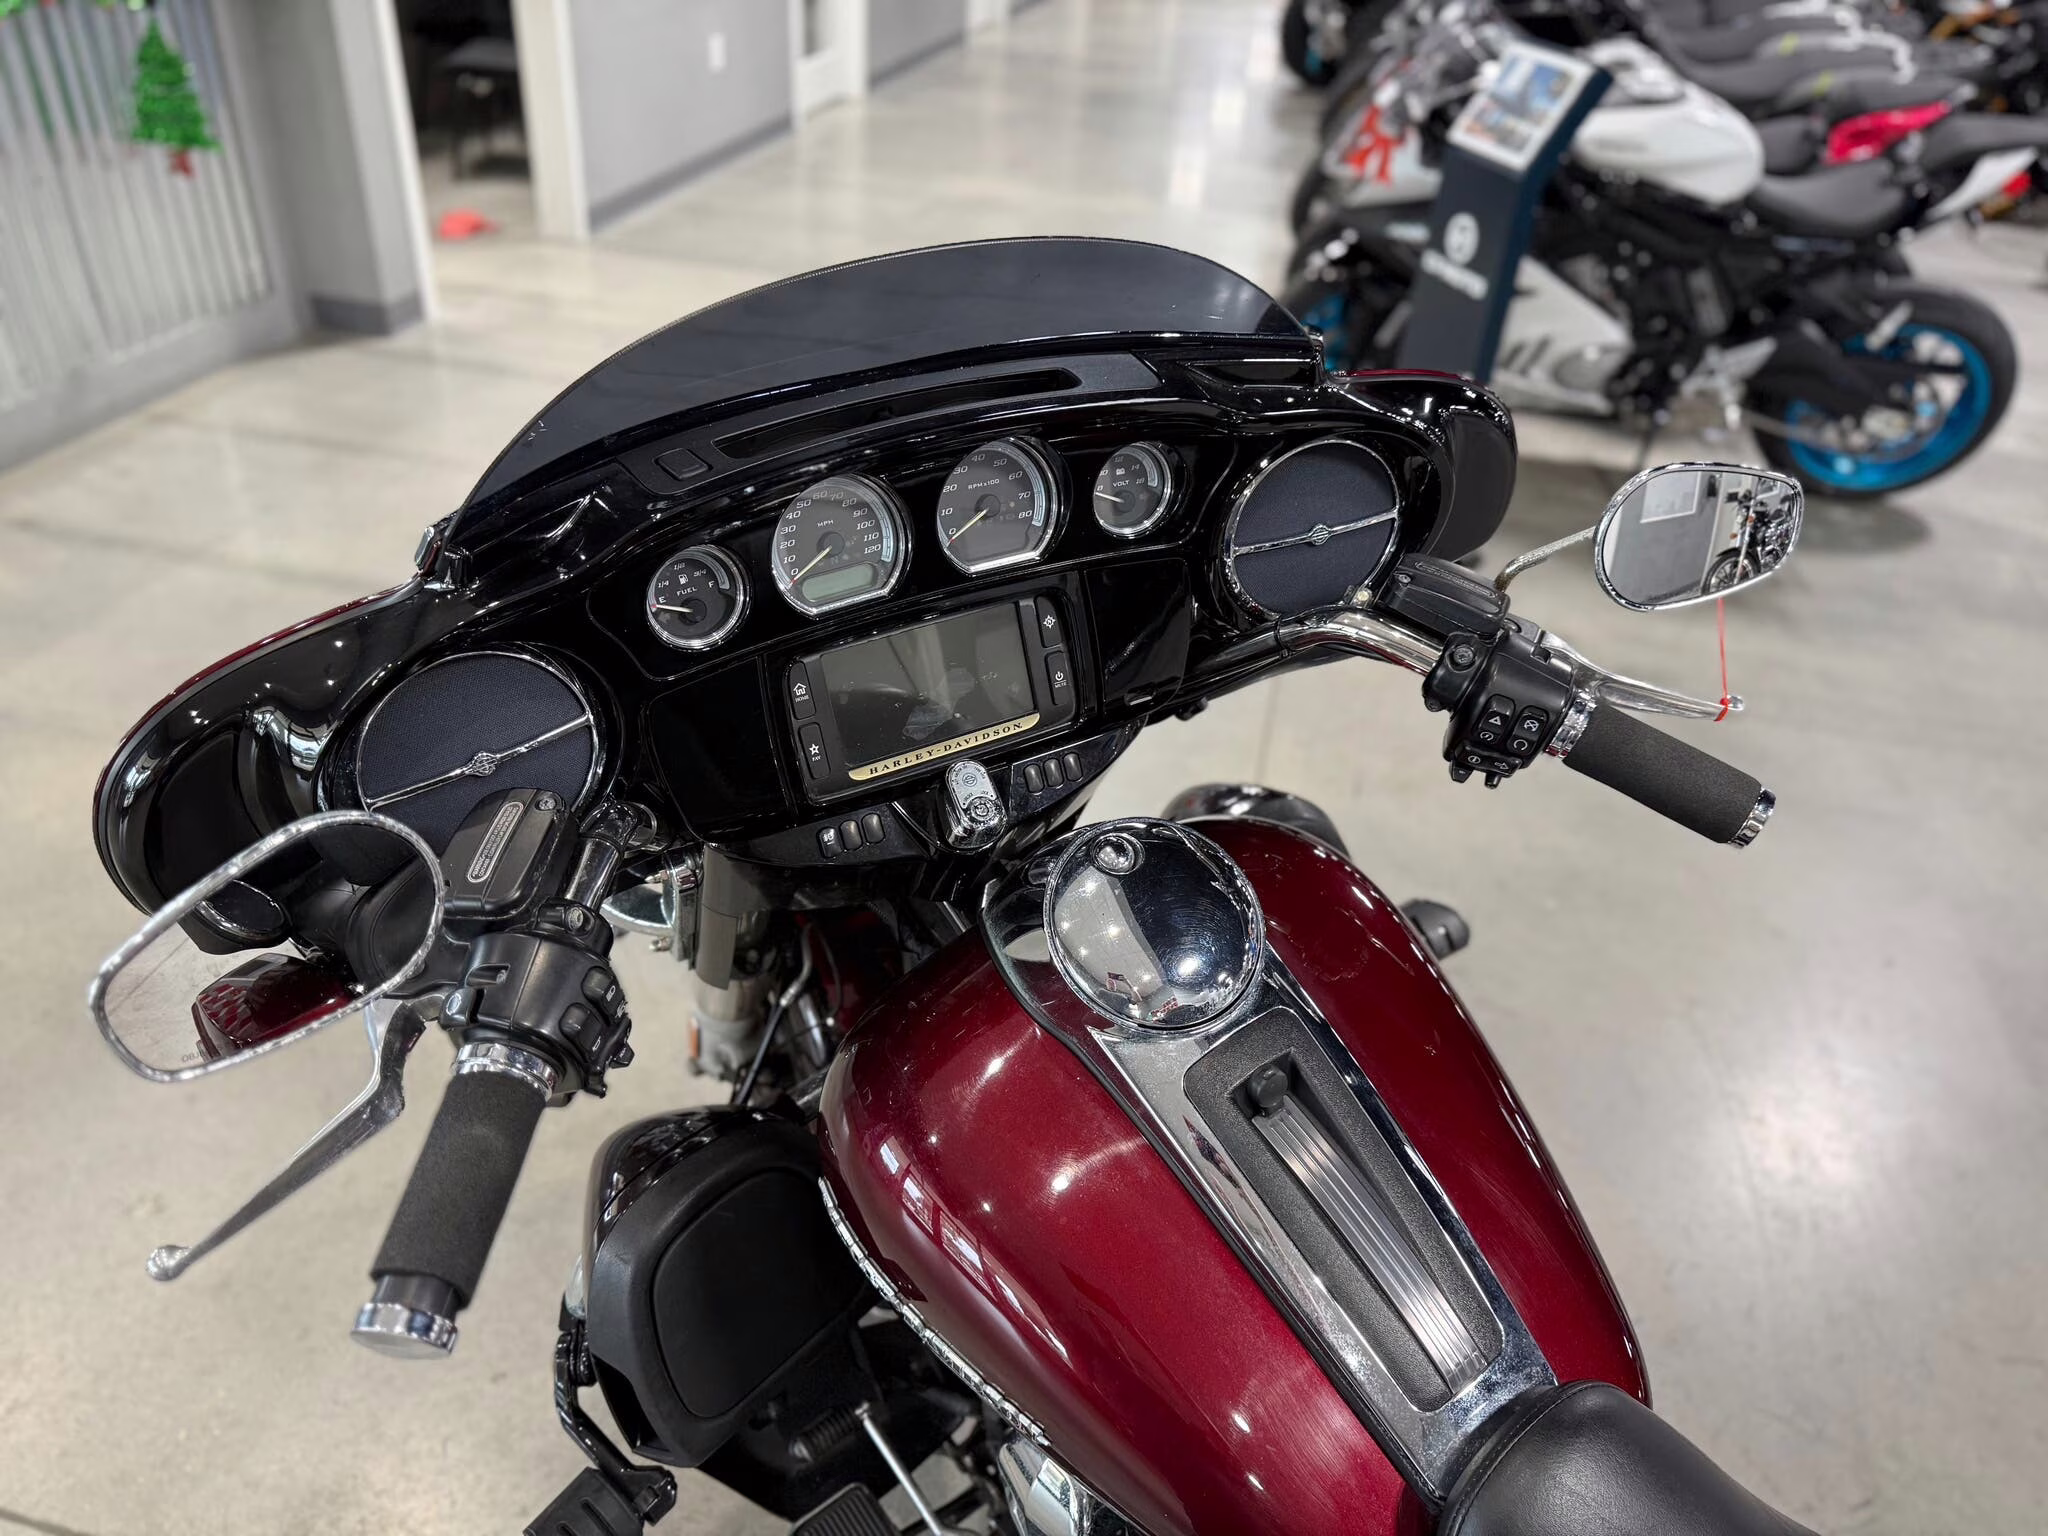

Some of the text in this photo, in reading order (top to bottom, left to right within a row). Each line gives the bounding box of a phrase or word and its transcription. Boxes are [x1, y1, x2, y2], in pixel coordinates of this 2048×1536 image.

[993, 459, 1007, 467] 50
[953, 465, 968, 475] 30
[1008, 470, 1023, 481] 60
[1112, 479, 1130, 487] VOLT
[942, 484, 957, 493] 20
[813, 490, 828, 500] 60
[830, 491, 844, 501] 70
[1018, 491, 1031, 500] 70
[796, 499, 812, 509] 50
[842, 497, 857, 508] 80
[785, 510, 801, 520] 40
[852, 507, 868, 518] 90
[940, 507, 953, 516] 10
[1018, 510, 1033, 519] 80
[816, 519, 834, 528] MPH
[856, 519, 876, 530] 100
[780, 524, 796, 535] 30
[948, 527, 957, 535] 0
[863, 531, 880, 542] 110
[780, 539, 796, 549] 20
[864, 543, 882, 554] 120
[783, 554, 796, 564] 10
[790, 567, 799, 576] 0
[657, 579, 670, 588] 1/4
[708, 580, 716, 588] F
[676, 586, 698, 597] FUEL
[658, 596, 667, 604] E
[794, 694, 809, 703] HOME
[869, 721, 1023, 775] HARLEY-DAVIDSON
